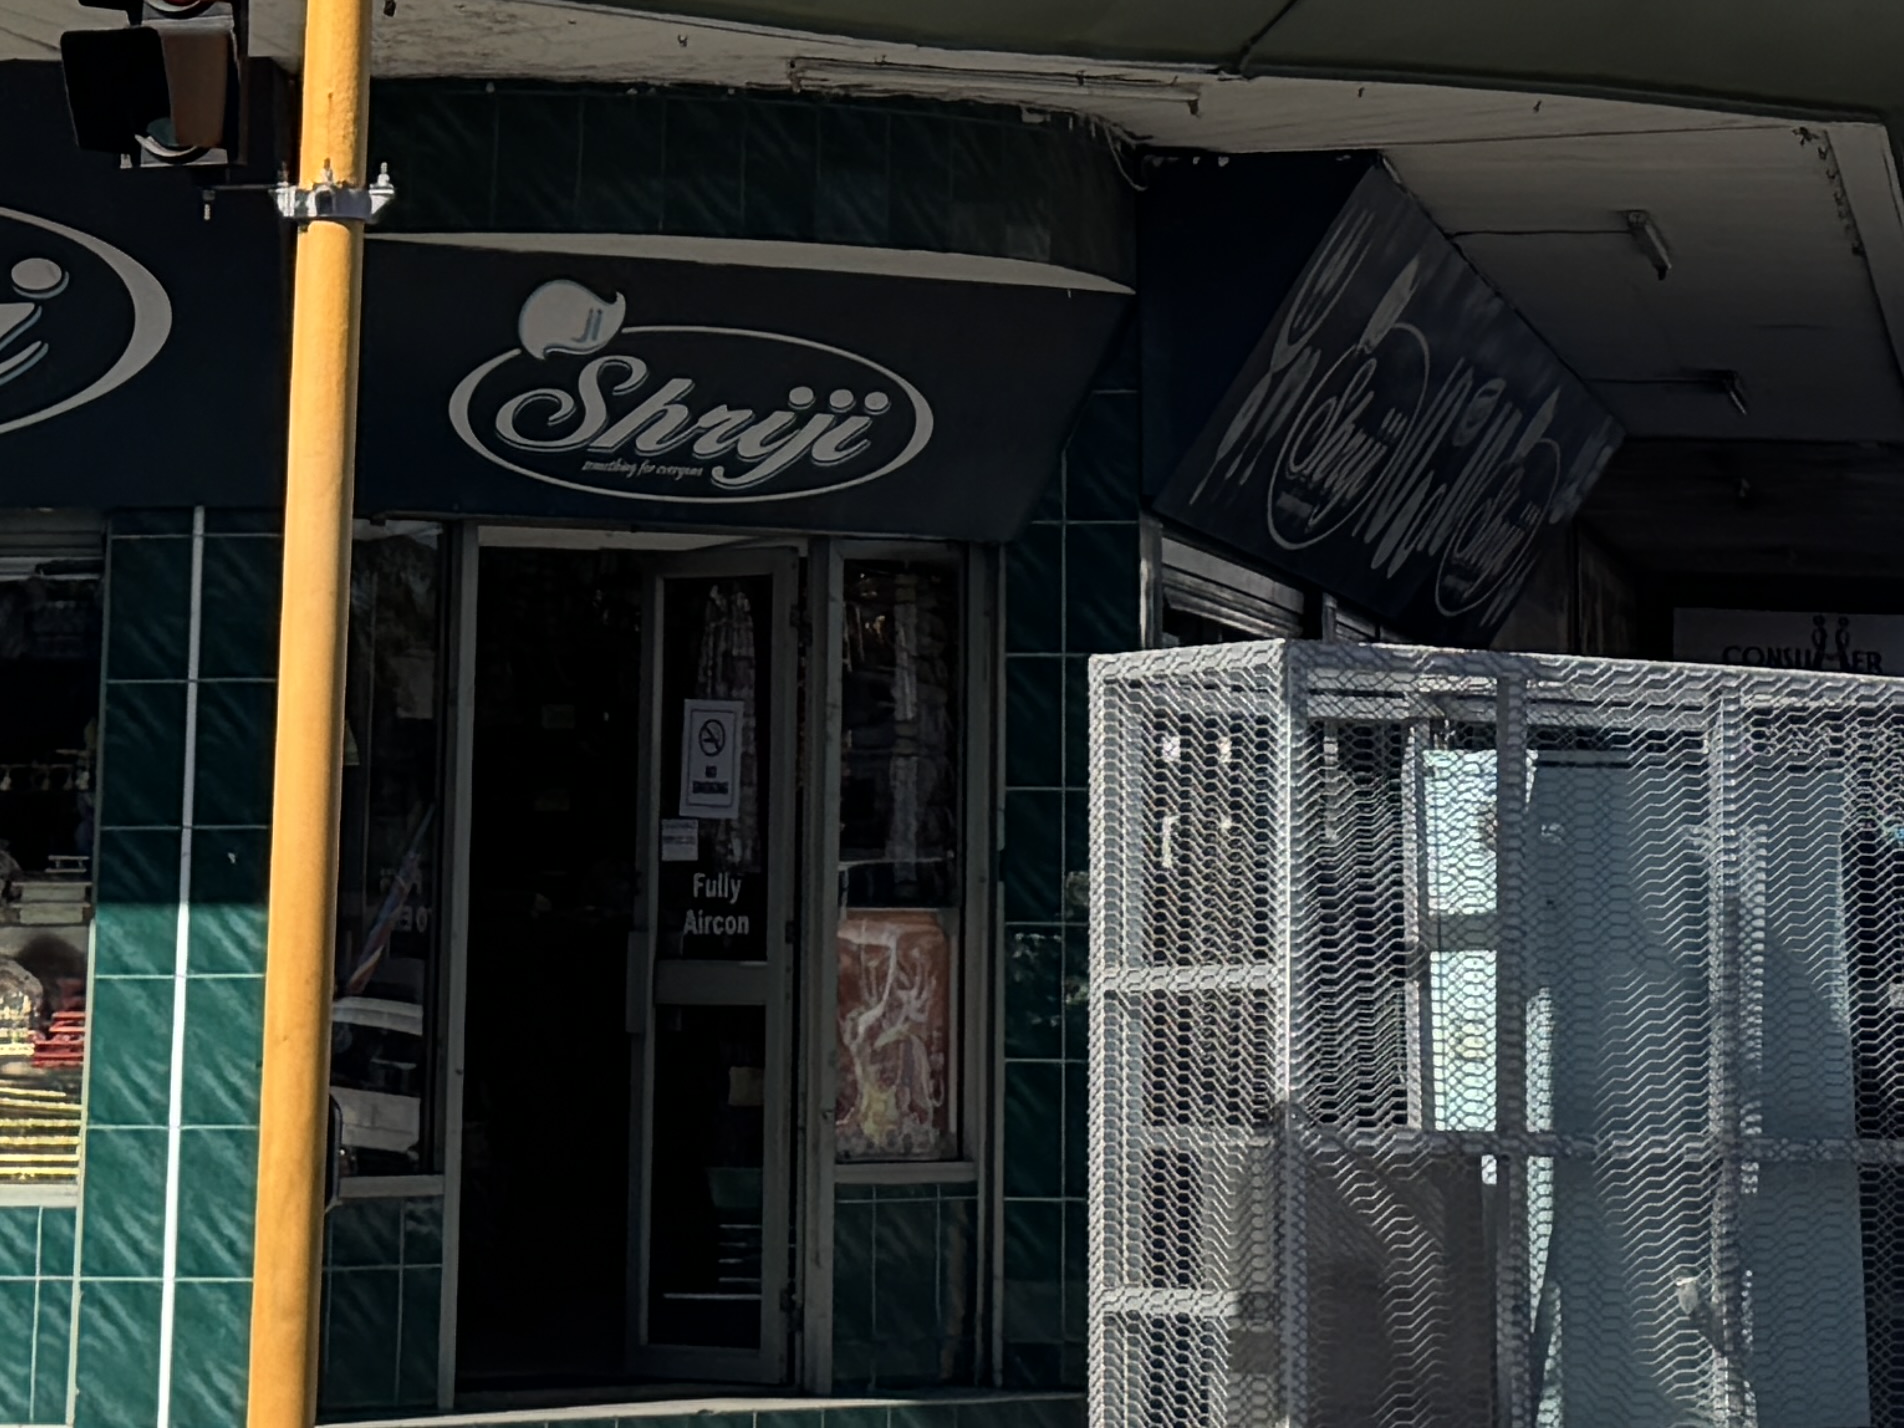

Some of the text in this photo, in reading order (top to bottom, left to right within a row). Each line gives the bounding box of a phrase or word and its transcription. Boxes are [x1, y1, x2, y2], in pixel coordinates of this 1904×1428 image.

[495, 355, 890, 489] Shriji
[693, 873, 743, 904] Fully
[683, 909, 750, 935] Aircon
